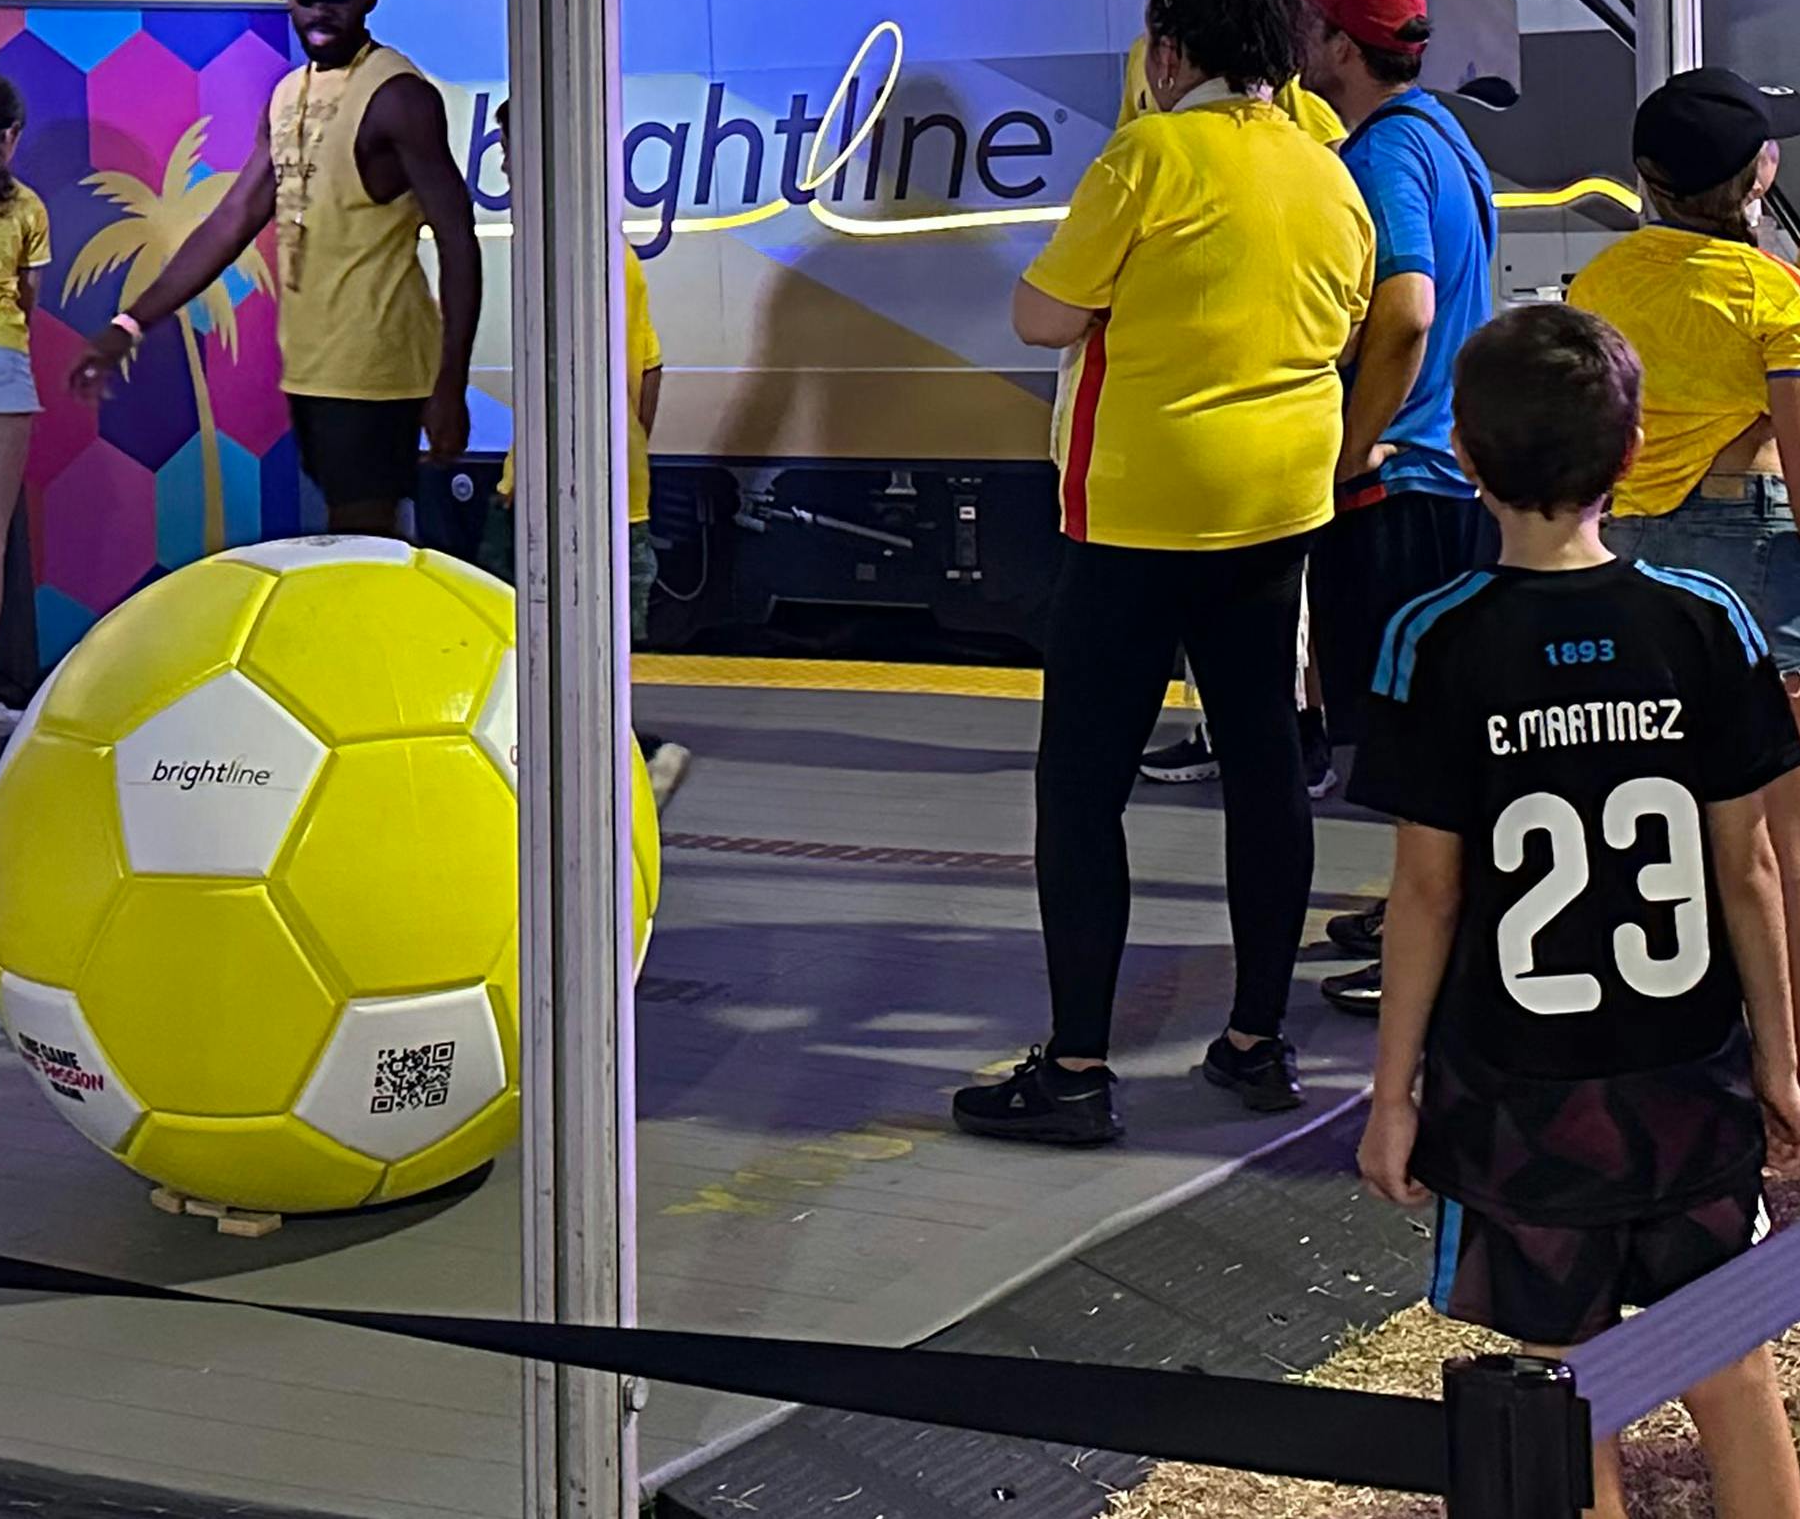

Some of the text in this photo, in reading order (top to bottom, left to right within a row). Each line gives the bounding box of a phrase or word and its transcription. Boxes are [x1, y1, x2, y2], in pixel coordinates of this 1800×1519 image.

[468, 77, 1054, 261] bghtline
[1543, 638, 1616, 667] 1893
[1486, 697, 1685, 756] E.MARTINEZ
[151, 758, 271, 791] brightline
[1492, 776, 1711, 1015] 23
